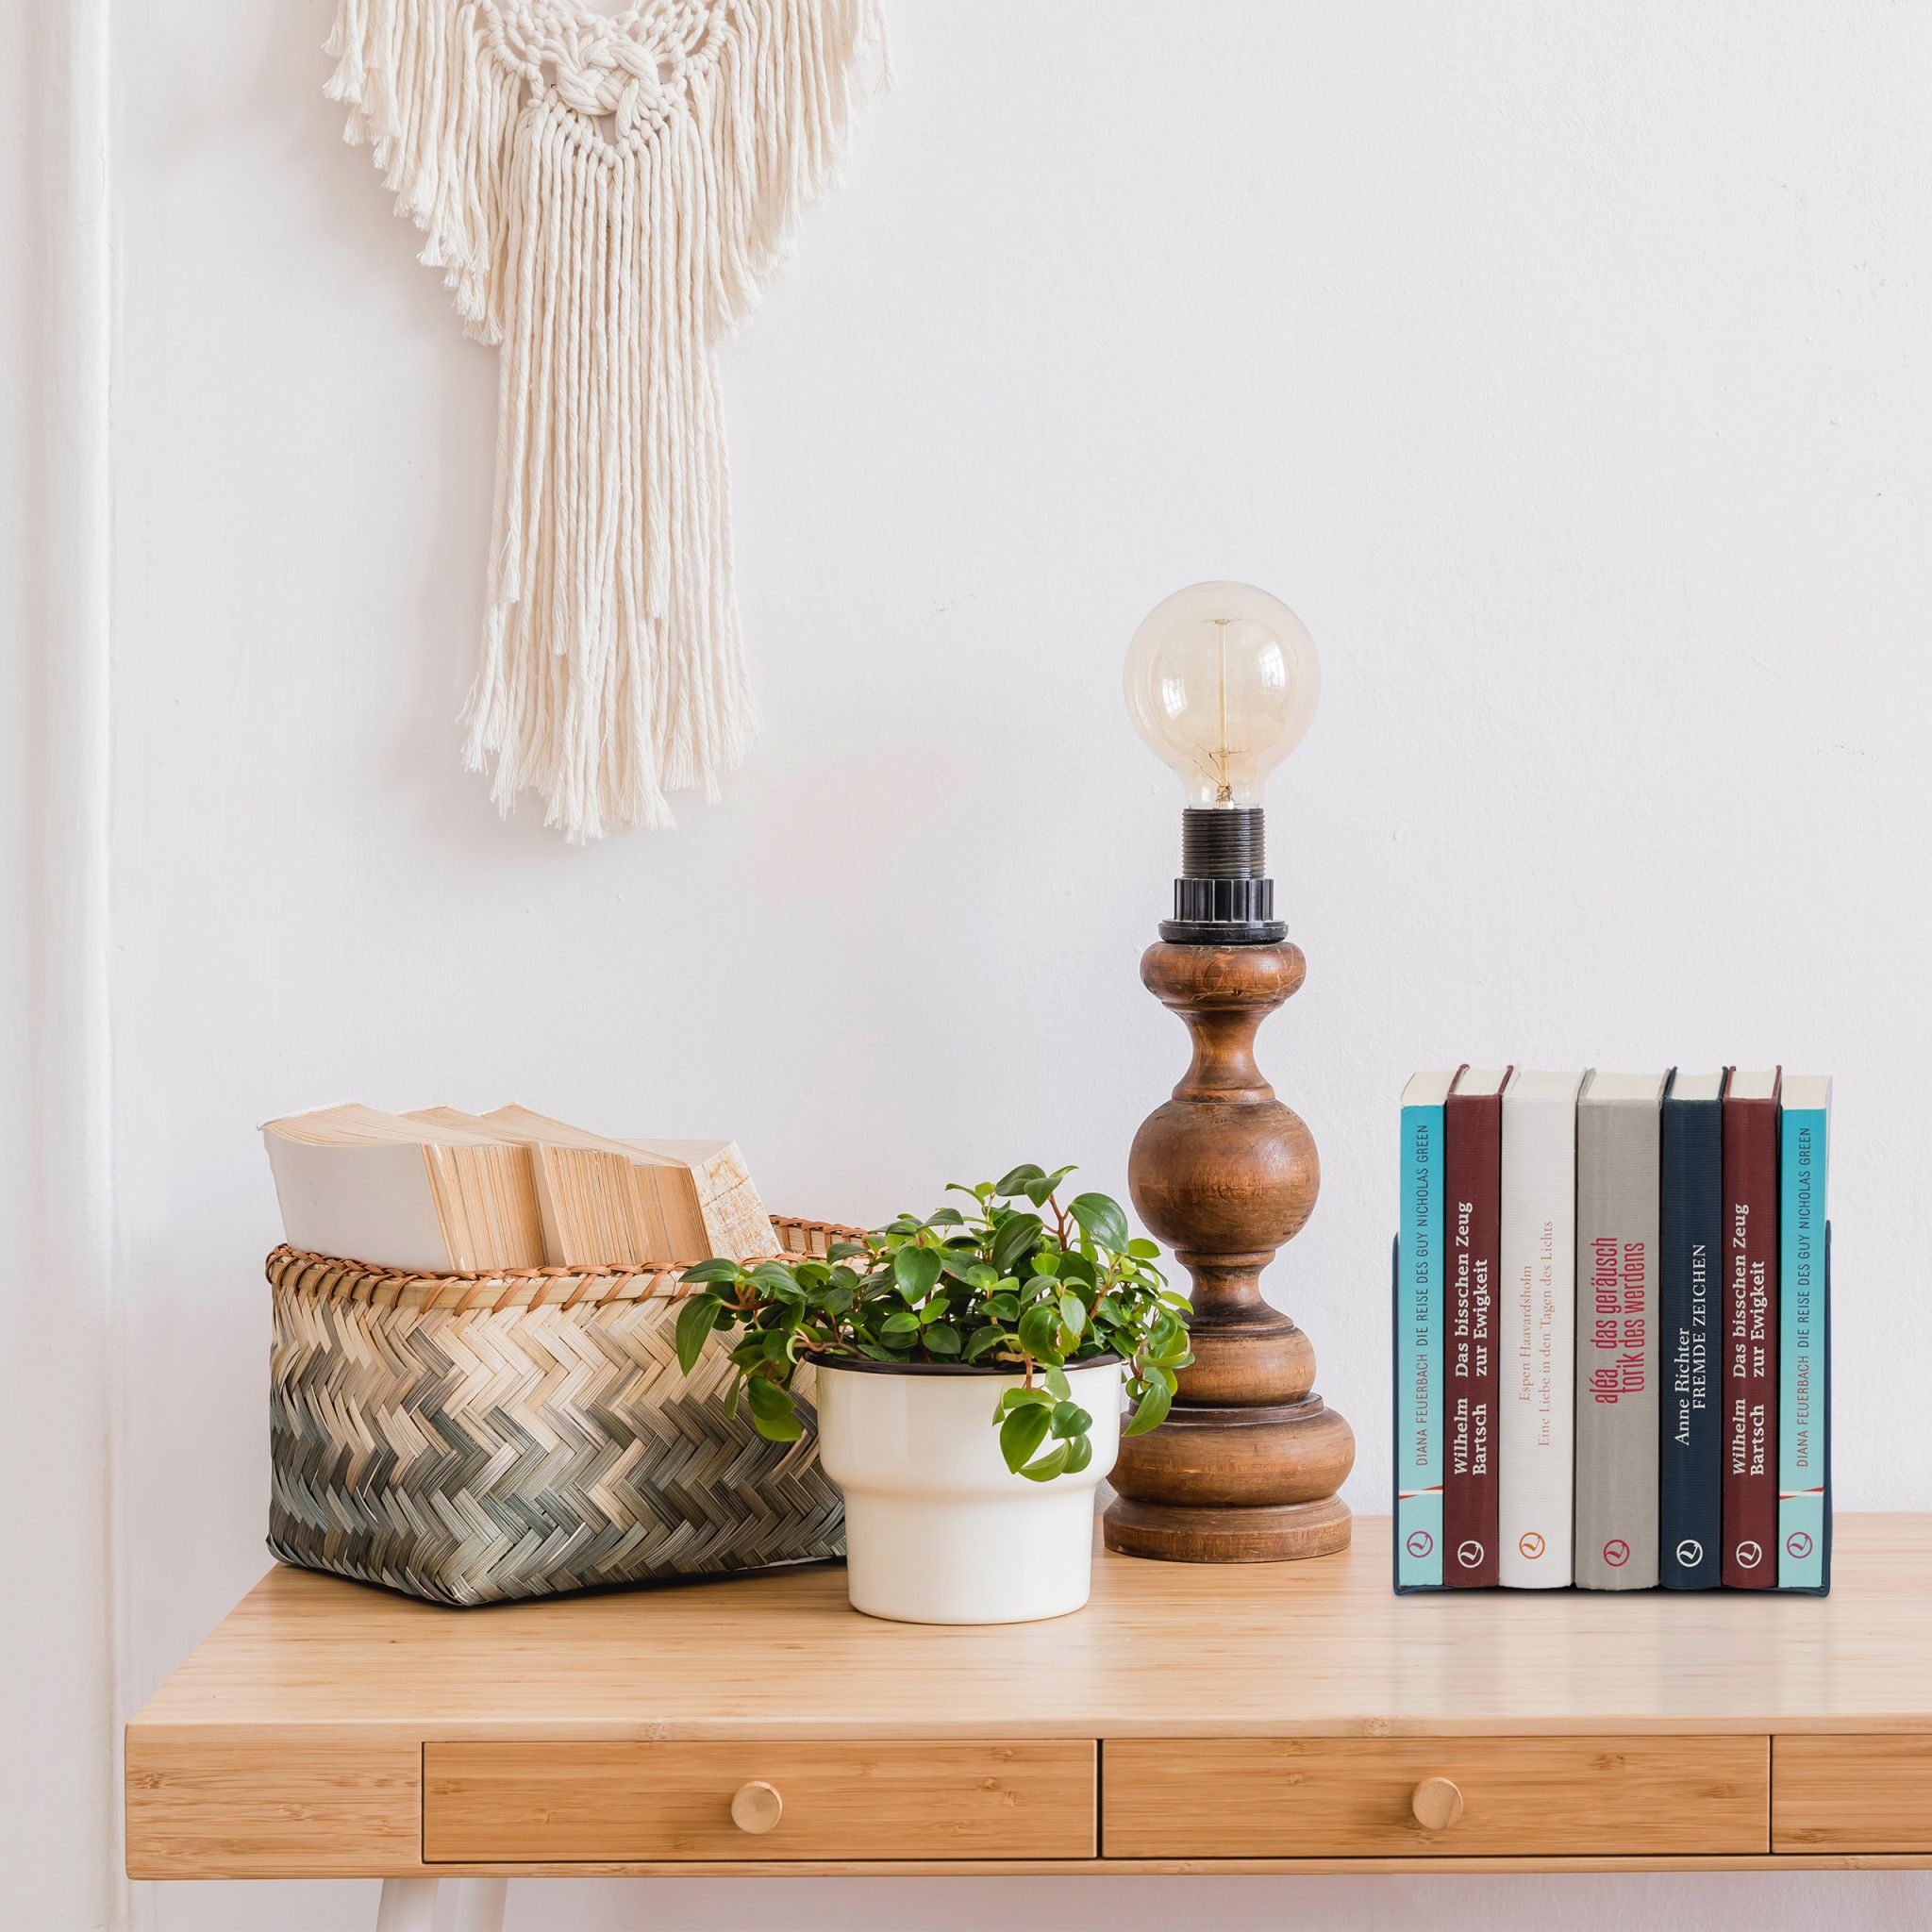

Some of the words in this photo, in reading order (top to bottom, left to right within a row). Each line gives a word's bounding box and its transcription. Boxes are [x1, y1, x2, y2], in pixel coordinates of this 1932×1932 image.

[1416, 1124, 1429, 1163] GREEN
[1798, 1127, 1811, 1166] GREEN
[1415, 1168, 1429, 1227] NICHOLAS
[1797, 1170, 1811, 1229] NICHOLAS
[1455, 1201, 1474, 1247] Zeug
[1540, 1221, 1553, 1260] Lichts
[1732, 1203, 1750, 1249] Zeug
[1415, 1232, 1429, 1257] GUY
[1797, 1234, 1811, 1259] GUY
[1415, 1260, 1429, 1284] DES
[1539, 1265, 1552, 1287] des
[1591, 1238, 1622, 1313] geräusch
[1619, 1242, 1644, 1313] werdens
[1692, 1244, 1707, 1327] ZEICHEN
[1797, 1263, 1810, 1286] DES
[1415, 1288, 1428, 1322] REISE
[1454, 1252, 1470, 1337] bisschen
[1473, 1258, 1491, 1340] Ewigkeit
[1519, 1266, 1532, 1357] Haavardsholm
[1539, 1290, 1556, 1329] Tagen
[1732, 1254, 1746, 1338] bisschen
[1749, 1260, 1768, 1341] Ewigkeit
[1797, 1291, 1810, 1324] REISE
[1415, 1326, 1428, 1346] DIE
[1538, 1333, 1552, 1357] den
[1590, 1319, 1618, 1349] das
[1619, 1319, 1644, 1348] des
[1797, 1328, 1809, 1348] DIE
[1455, 1342, 1469, 1378] Das
[1475, 1344, 1488, 1377] zur
[1539, 1361, 1551, 1374] in
[1616, 1352, 1644, 1393] torik
[1674, 1327, 1690, 1393] Richter
[1692, 1332, 1707, 1409] FREMDE
[1733, 1343, 1747, 1379] Das
[1753, 1345, 1765, 1378] zur
[1415, 1354, 1428, 1424] FEUERBACH
[1519, 1362, 1535, 1401] Espen
[1538, 1377, 1551, 1412] Liebe
[1590, 1369, 1620, 1404] aléa
[1796, 1356, 1809, 1425] FEUERBACH
[1453, 1397, 1468, 1475] Wilhelm
[1472, 1403, 1487, 1475] Bartsch
[1538, 1418, 1550, 1446] Eine
[1674, 1398, 1690, 1446] Anne
[1732, 1398, 1746, 1475] Wilhelm
[1749, 1404, 1765, 1476] Bartsch
[1415, 1428, 1428, 1466] DIANA
[1796, 1430, 1808, 1467] DIANA
